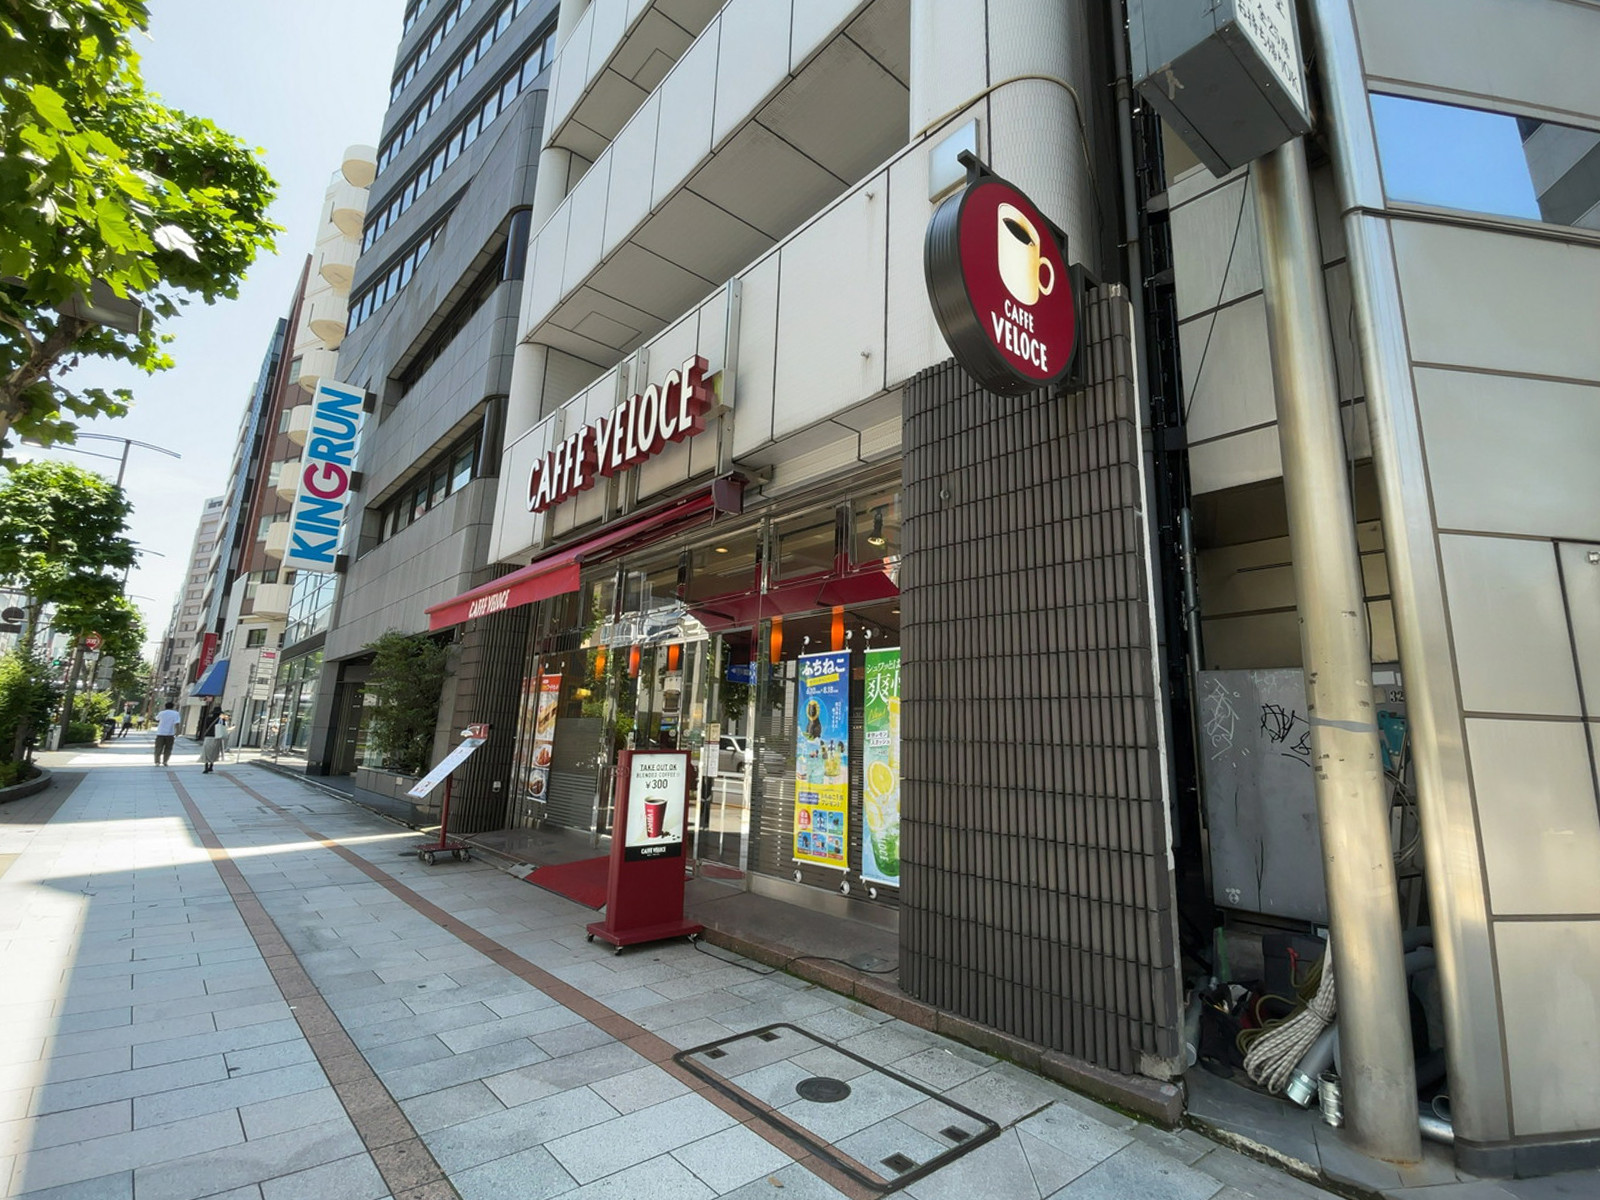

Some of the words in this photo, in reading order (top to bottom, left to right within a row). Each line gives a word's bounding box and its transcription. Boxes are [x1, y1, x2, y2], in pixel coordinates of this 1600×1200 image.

[1004, 299, 1034, 333] CAFFE
[991, 311, 1048, 373] VELOCE
[595, 355, 698, 474] VELOCE
[289, 386, 362, 563] KINGRUN
[802, 658, 845, 676] ふちねこ
[646, 779, 668, 789] ¥300
